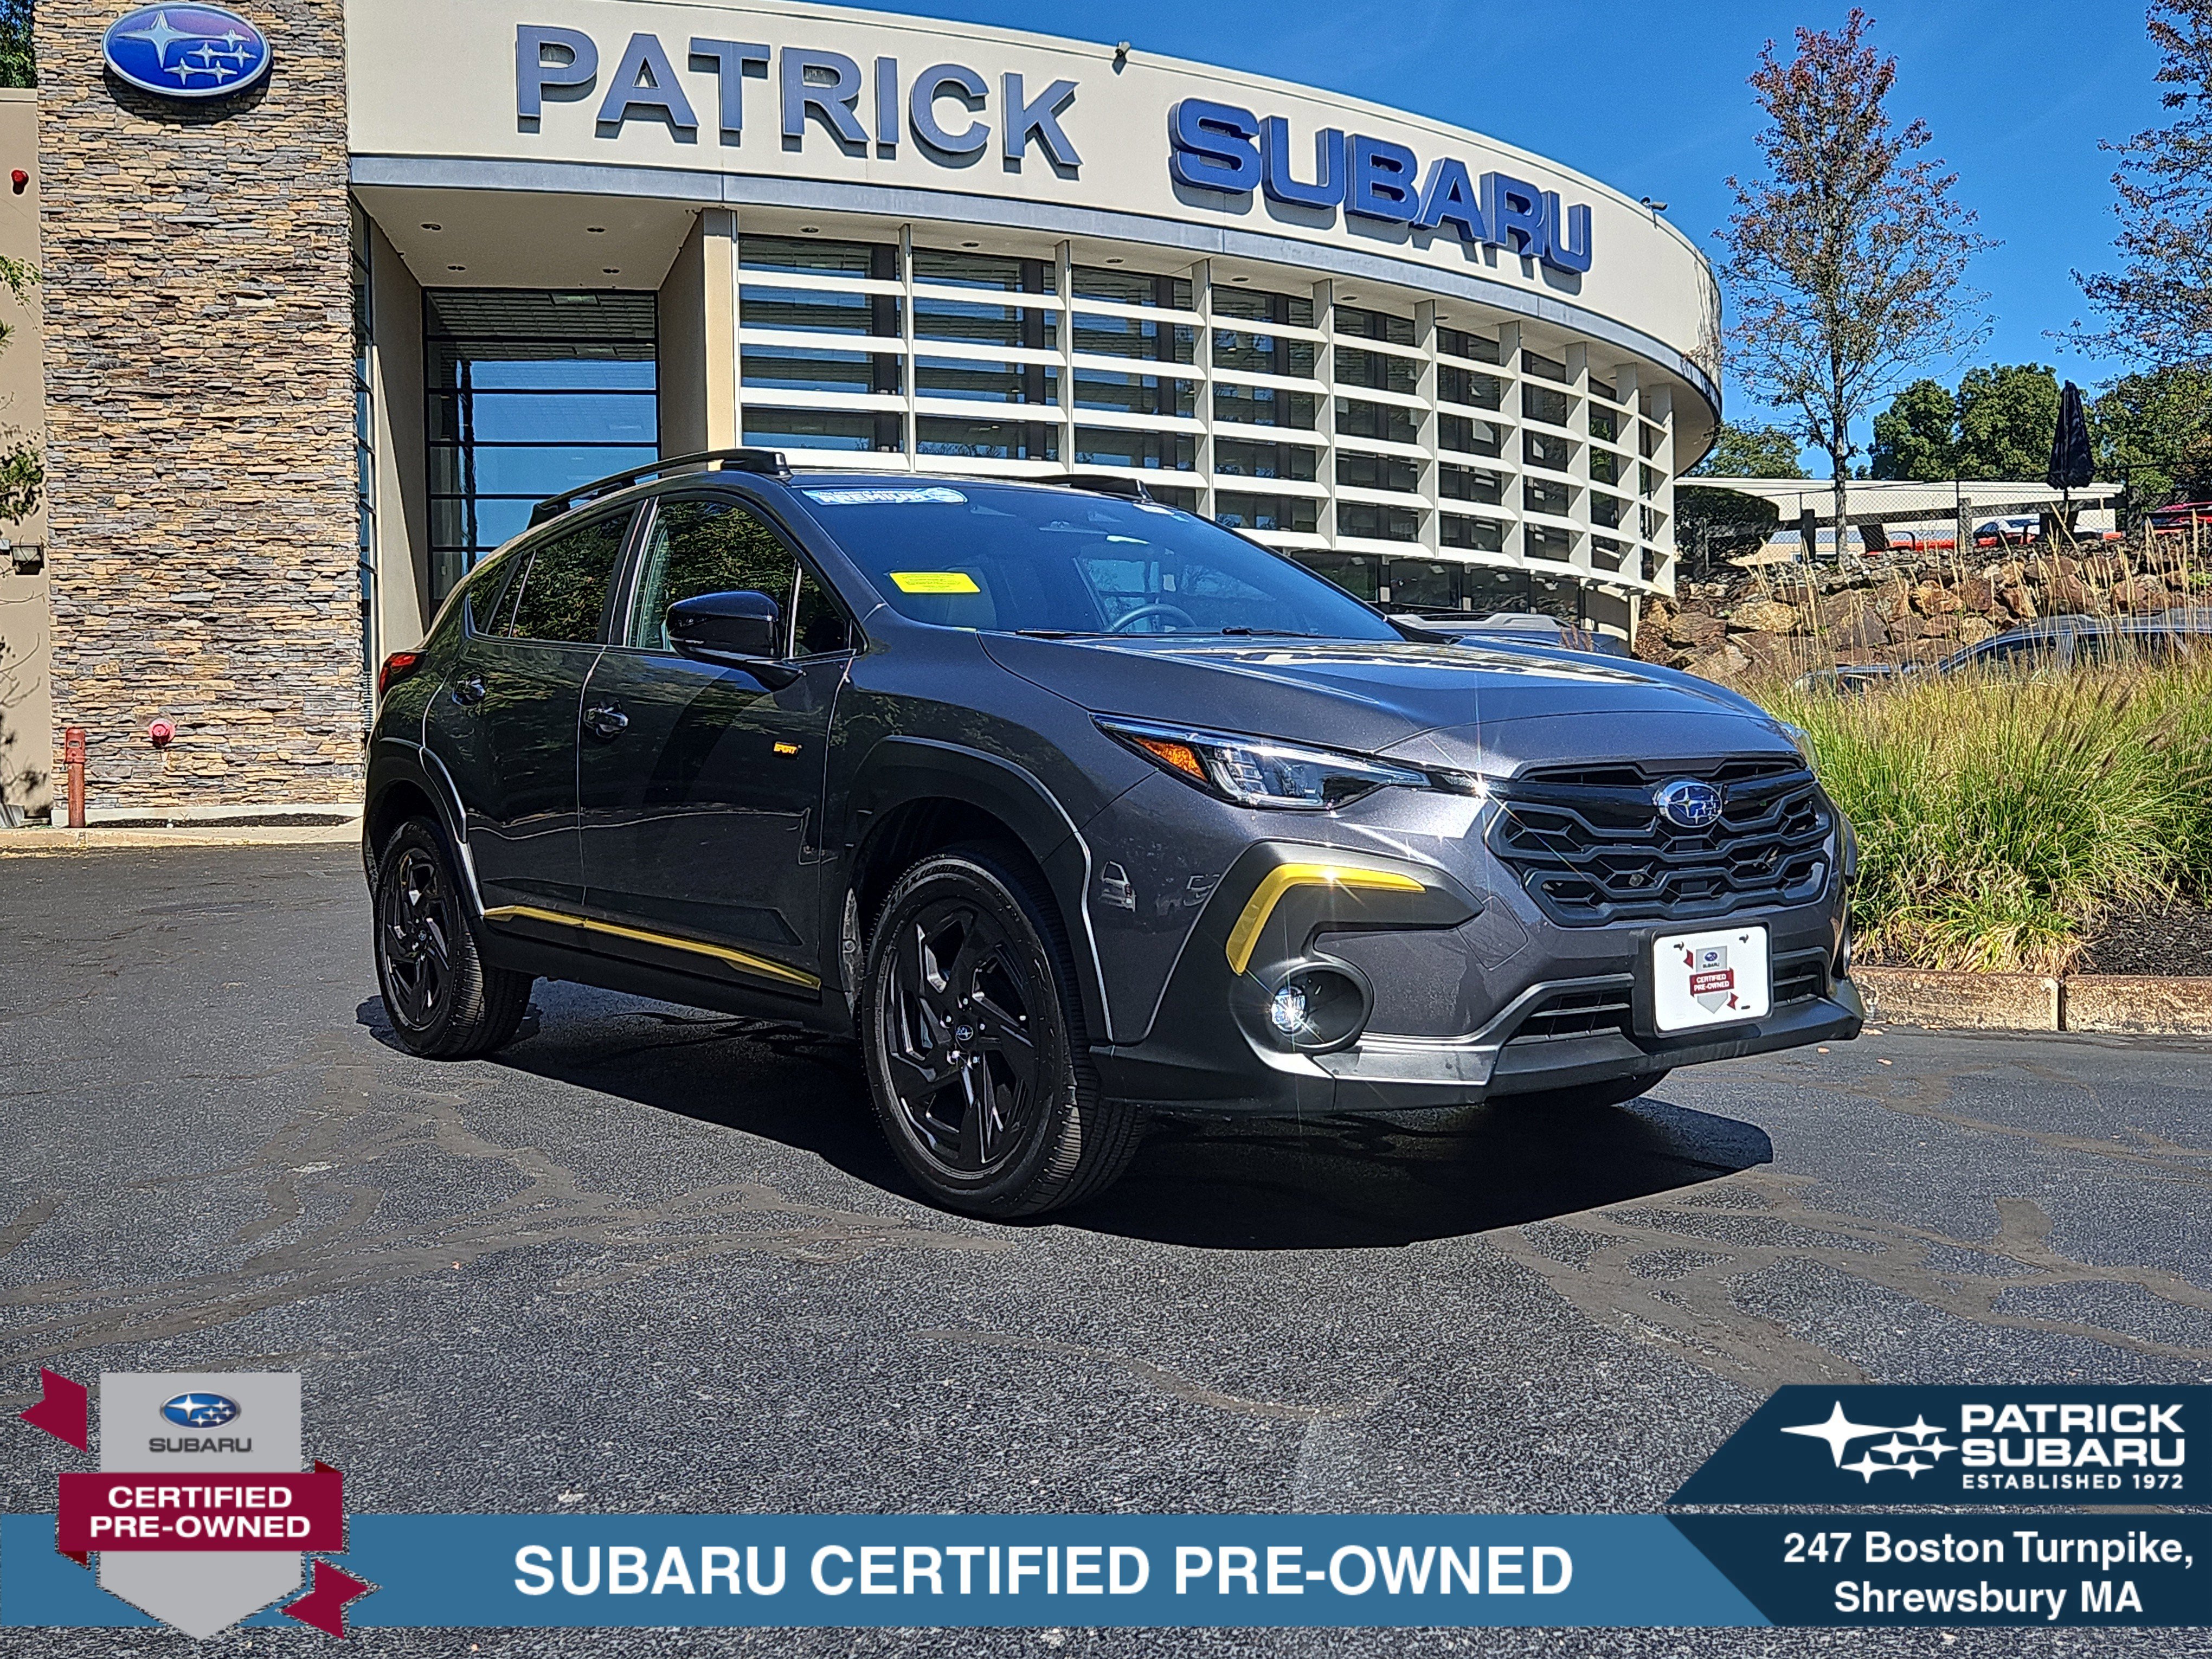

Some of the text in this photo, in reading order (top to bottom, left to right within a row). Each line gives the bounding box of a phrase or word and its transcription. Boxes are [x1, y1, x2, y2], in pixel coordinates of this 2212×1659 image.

[516, 24, 1593, 274] PATRICK SUBARU
[1696, 974, 1726, 983] CERTIFIED
[1694, 981, 1729, 992] PRE-OWNED
